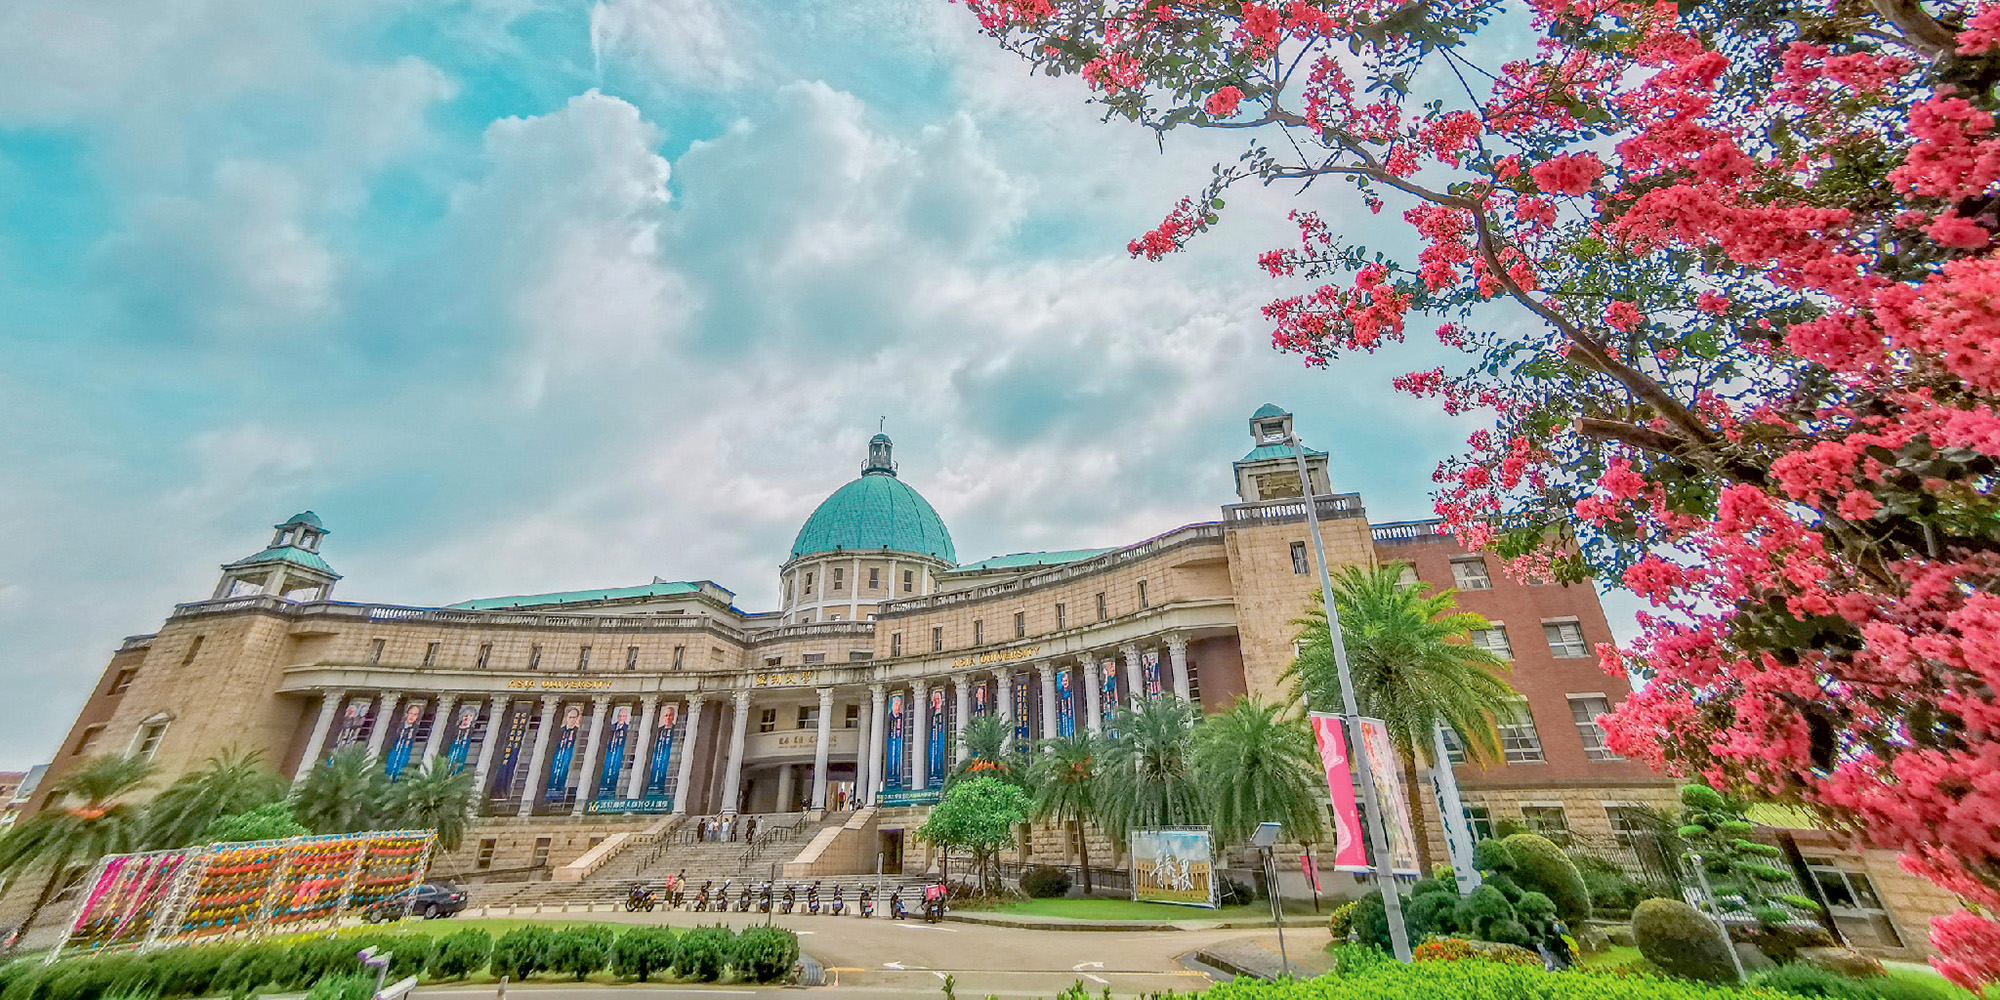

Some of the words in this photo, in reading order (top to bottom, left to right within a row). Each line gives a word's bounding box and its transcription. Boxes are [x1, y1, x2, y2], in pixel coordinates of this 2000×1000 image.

[952, 657, 976, 668] ASIA
[980, 646, 1041, 665] UNIVERSITY
[507, 679, 536, 688] ASIA
[541, 680, 614, 689] UNIVERSITY
[756, 671, 811, 686] 亞洲大學
